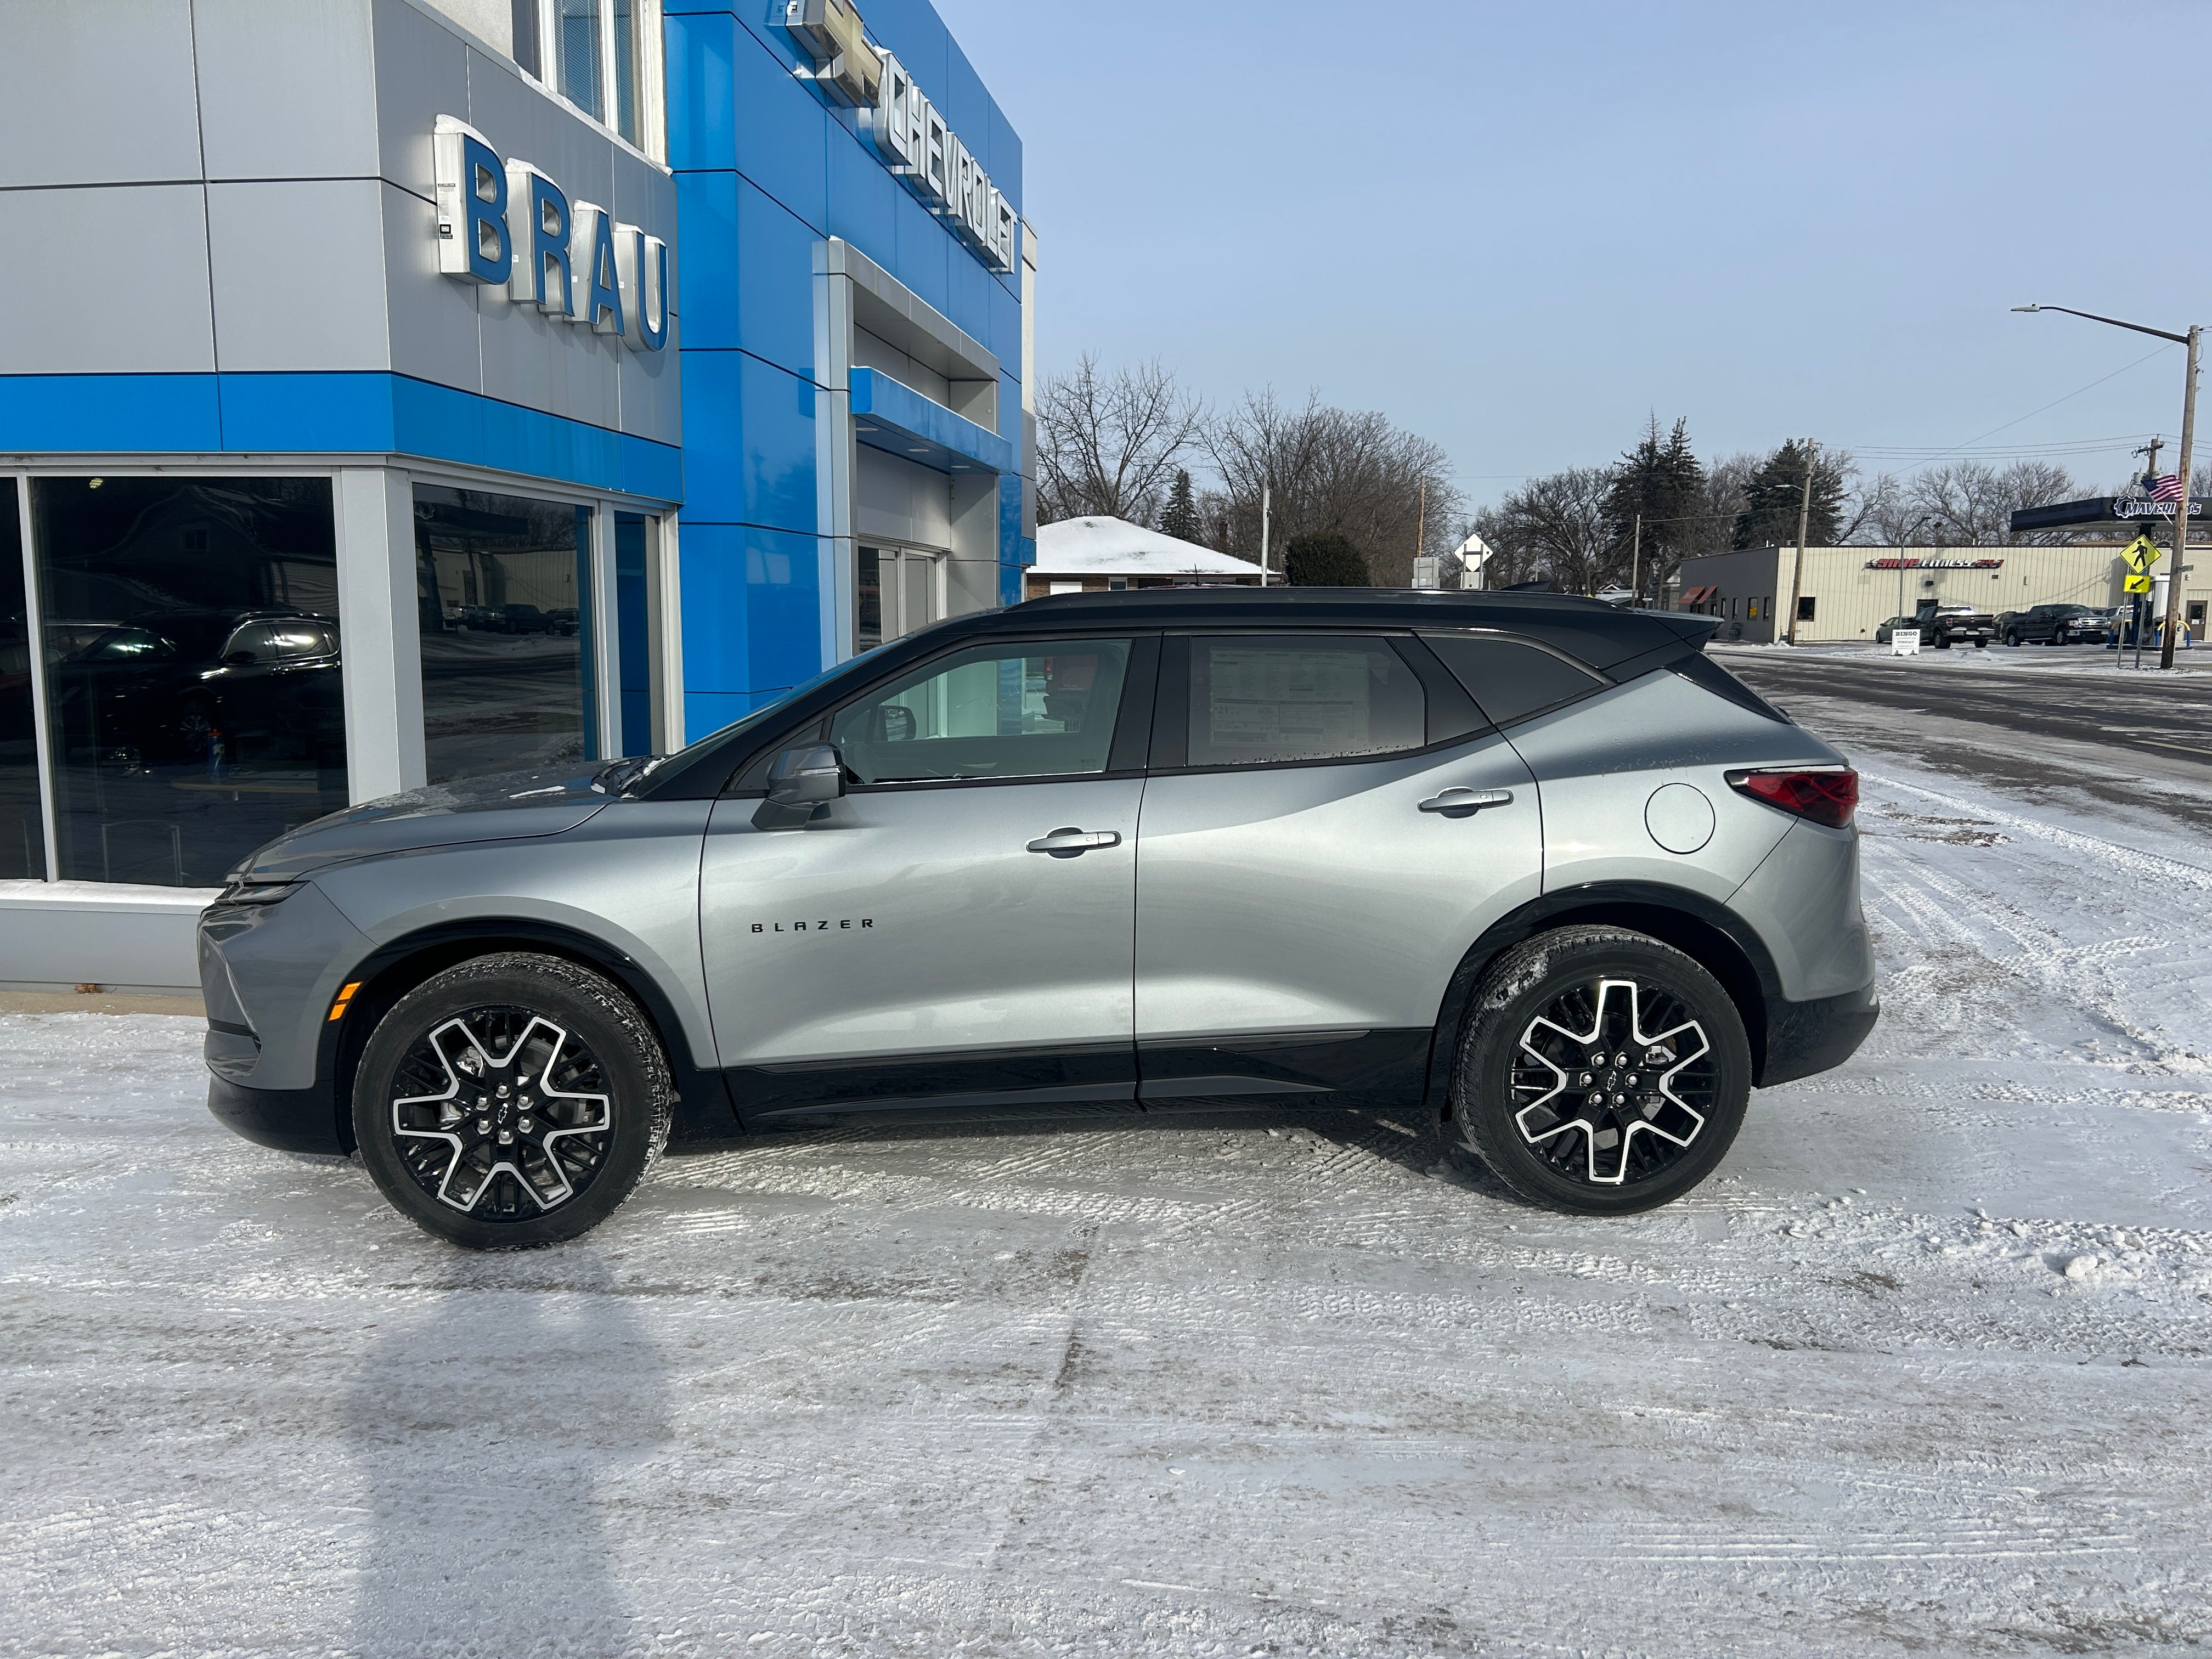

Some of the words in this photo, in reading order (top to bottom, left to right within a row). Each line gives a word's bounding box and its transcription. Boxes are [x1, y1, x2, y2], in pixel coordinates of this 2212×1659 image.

[881, 52, 1018, 274] CHEVROLET
[459, 131, 670, 352] BRAU
[1877, 558, 1920, 568] SNAP
[1921, 559, 1973, 567] FITNESS
[751, 918, 873, 933] BLAZER
